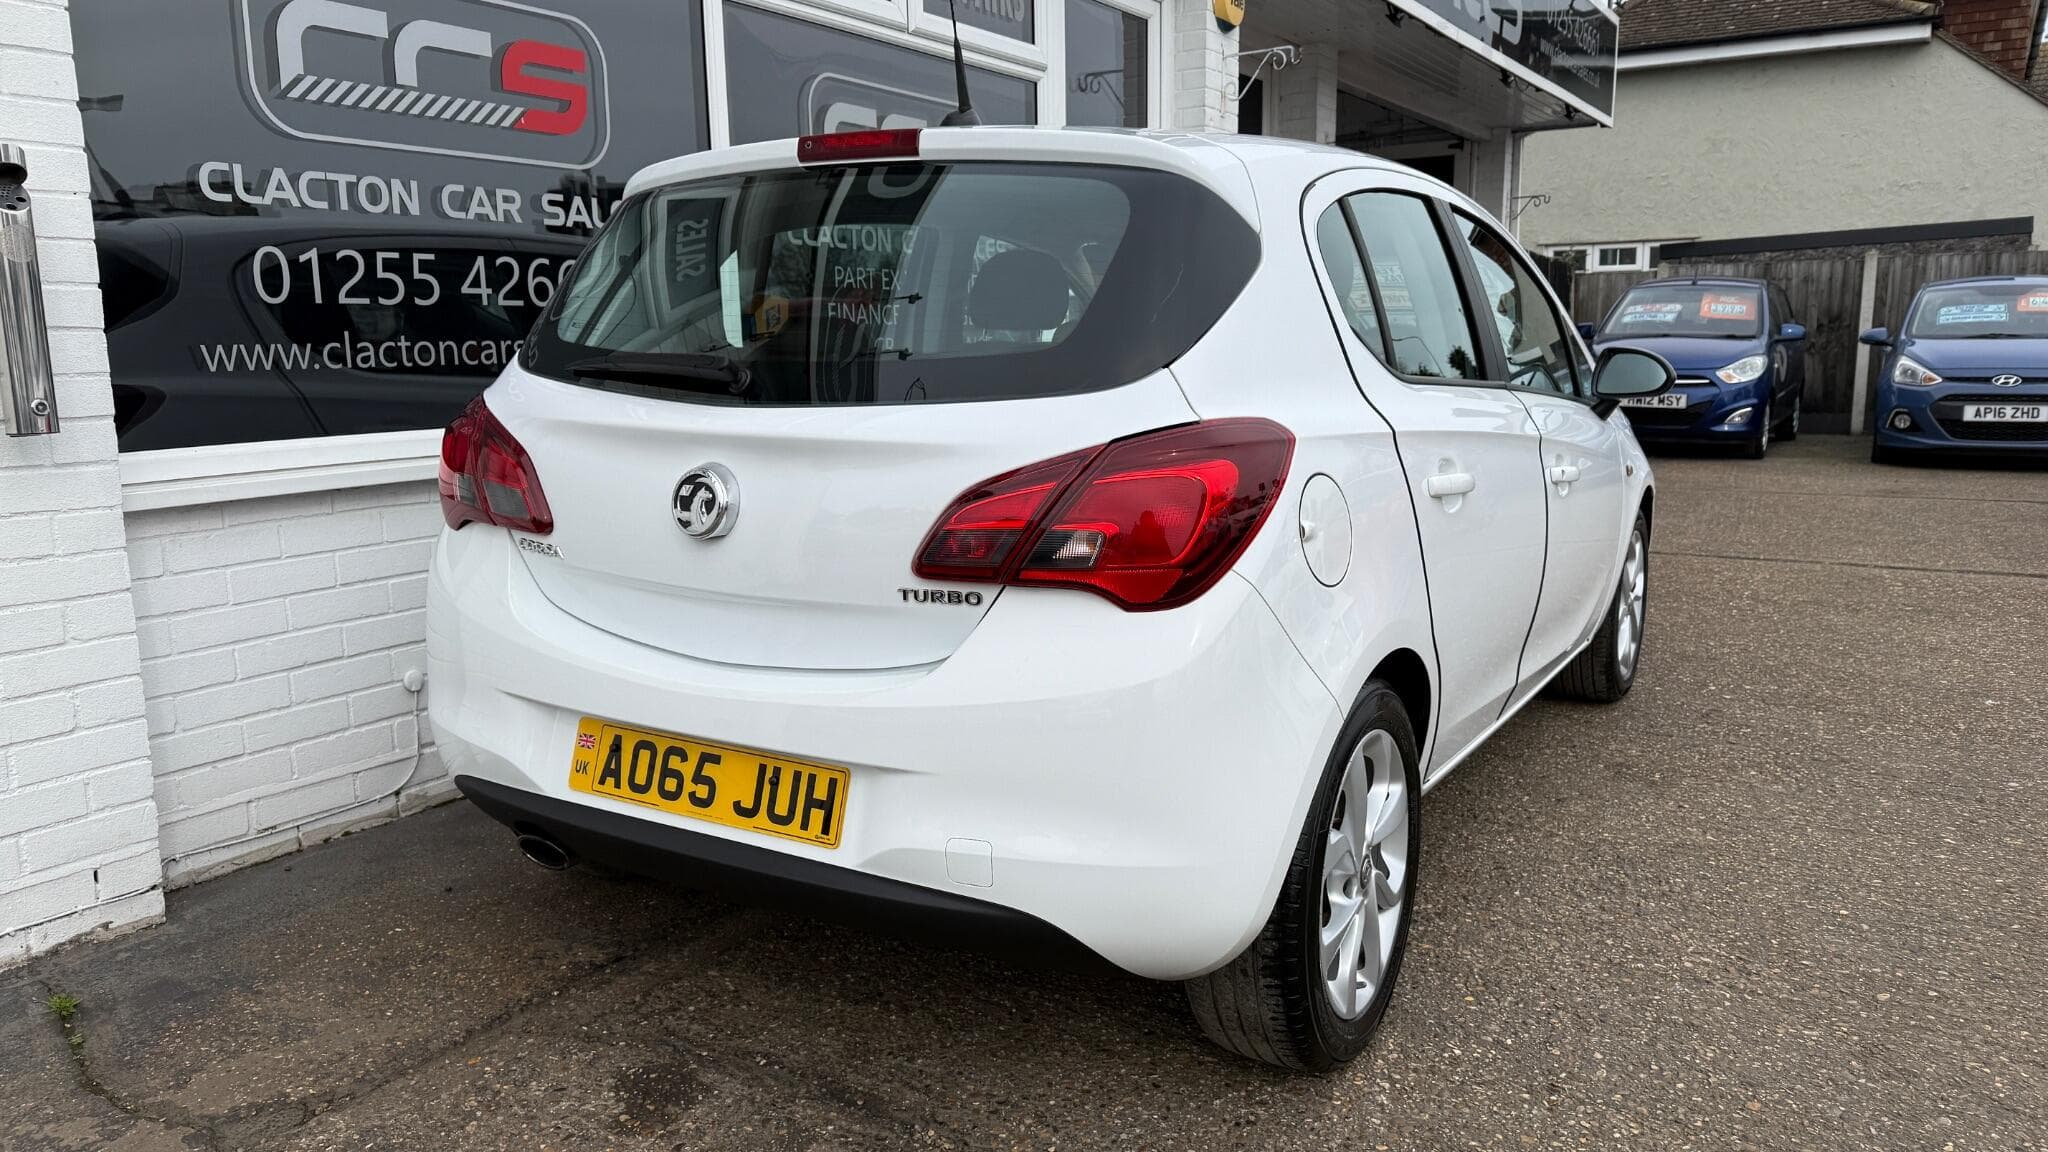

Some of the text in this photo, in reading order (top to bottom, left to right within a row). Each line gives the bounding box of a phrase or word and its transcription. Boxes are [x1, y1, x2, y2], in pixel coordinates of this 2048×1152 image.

[198, 161, 620, 229] CLACTON CAR SAL
[252, 245, 577, 308] 01255 426
[834, 265, 900, 291] PART EX
[1974, 406, 2040, 419] AP16 ZHD
[896, 588, 984, 606] TURBO
[574, 758, 590, 776] UK
[732, 762, 838, 837] JUH
